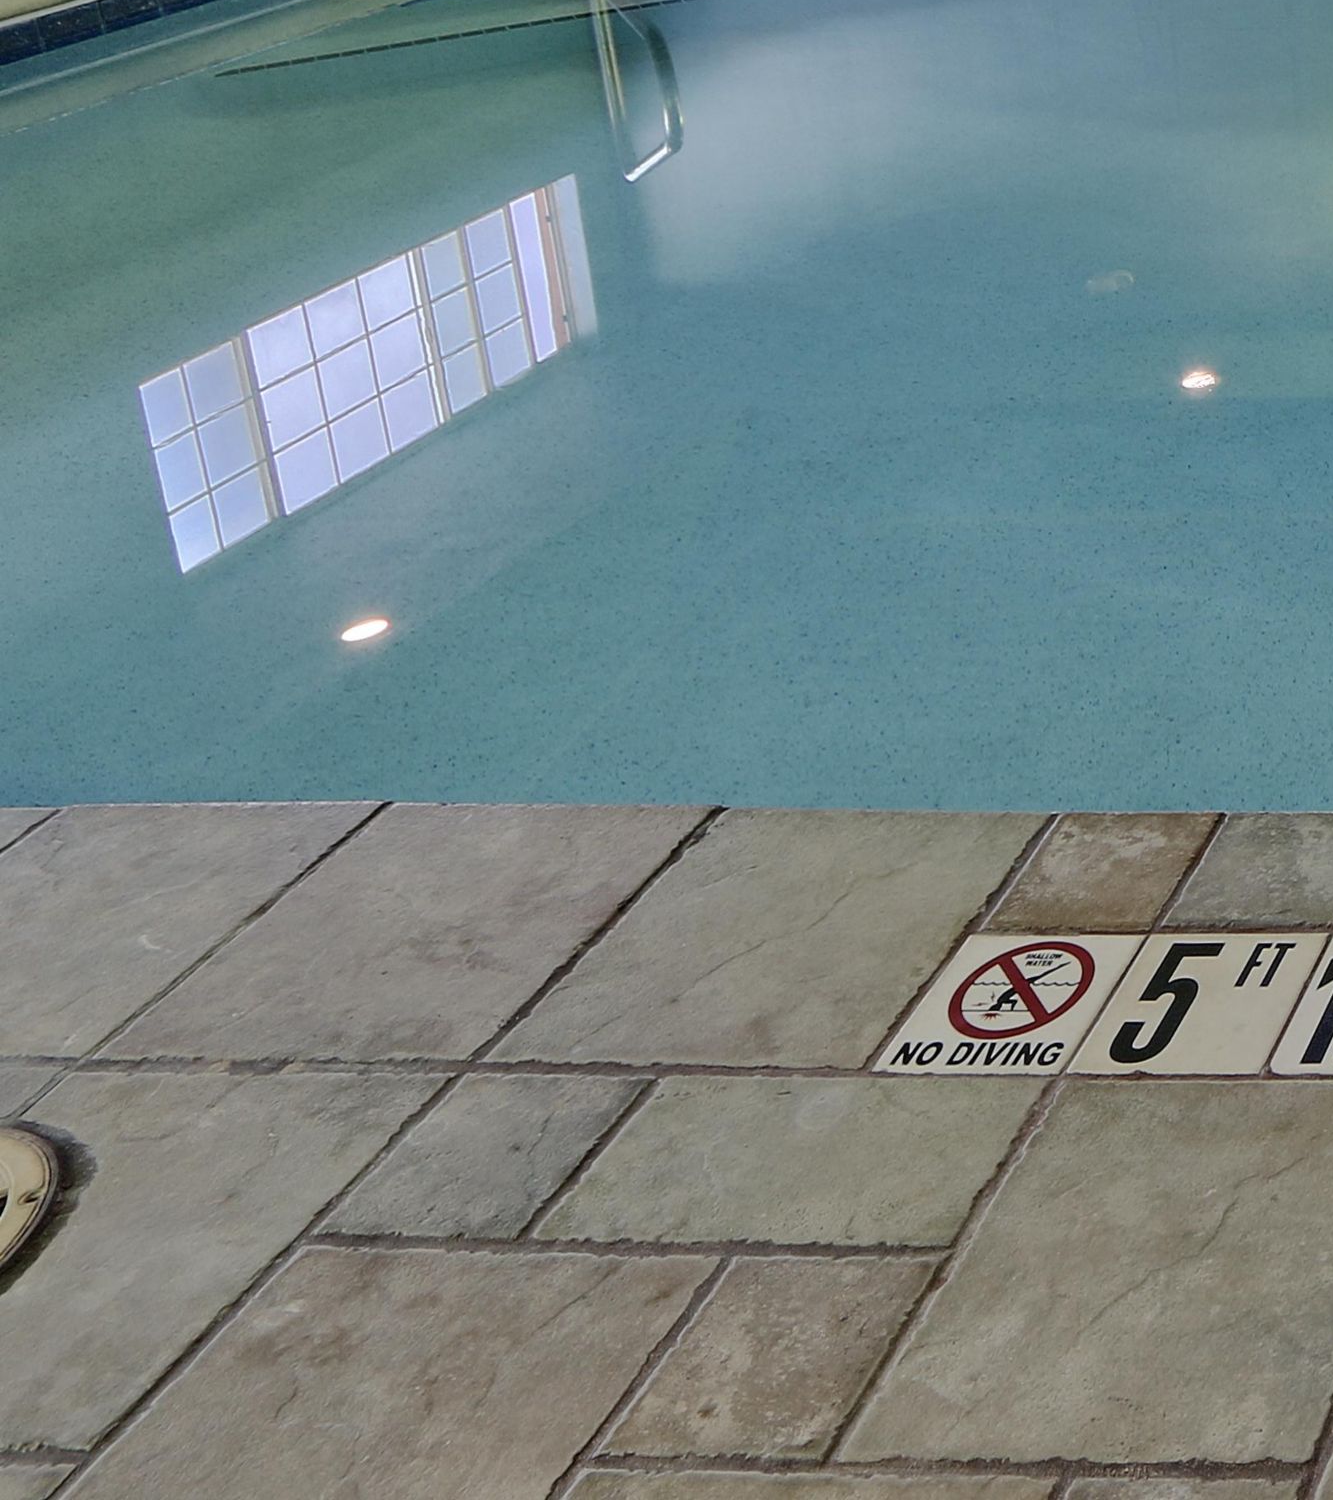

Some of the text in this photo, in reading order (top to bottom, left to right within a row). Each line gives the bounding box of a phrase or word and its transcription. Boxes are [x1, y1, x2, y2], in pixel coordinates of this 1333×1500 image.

[1109, 943, 1226, 1064] 5
[1234, 943, 1296, 987] FT
[890, 1042, 1064, 1066] NO DIVING
